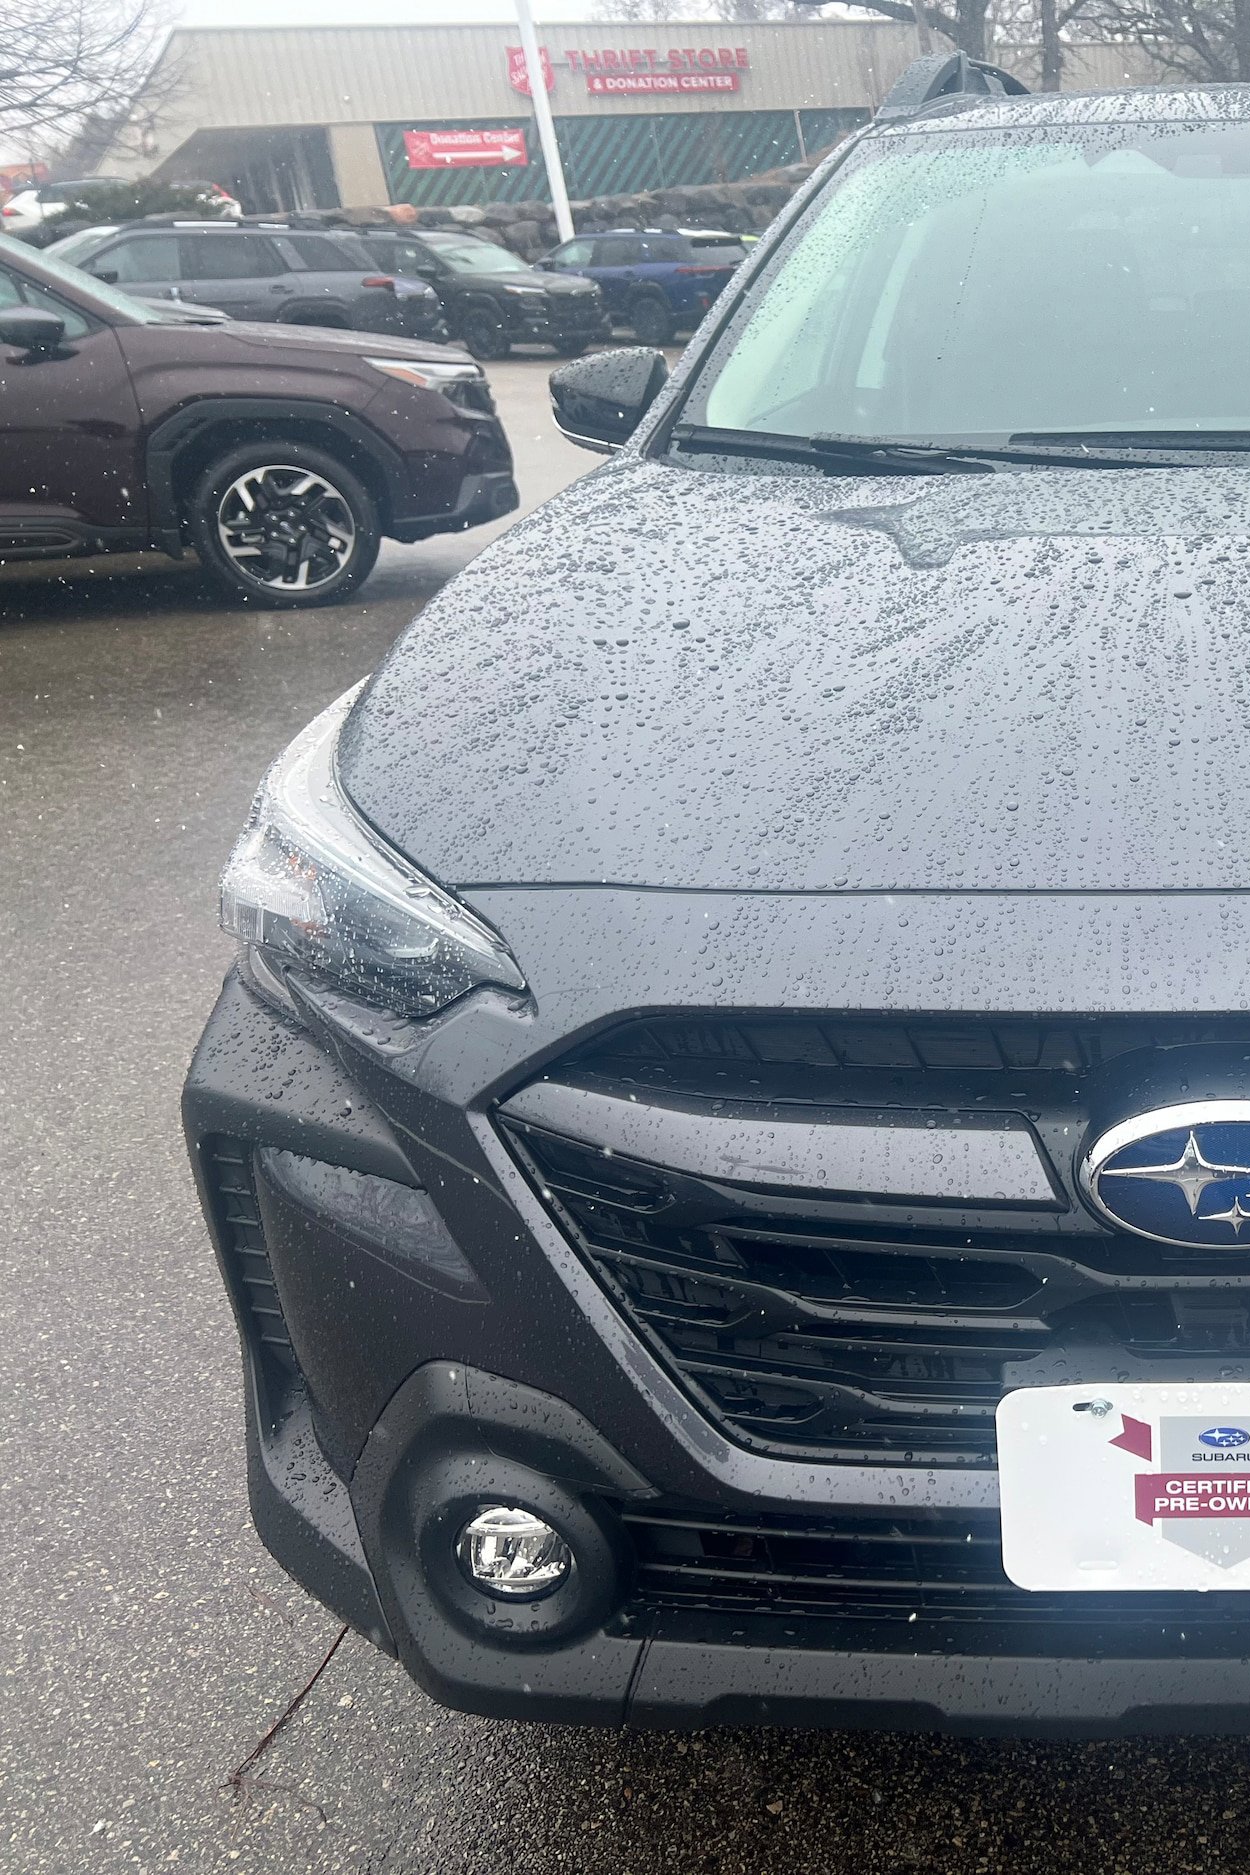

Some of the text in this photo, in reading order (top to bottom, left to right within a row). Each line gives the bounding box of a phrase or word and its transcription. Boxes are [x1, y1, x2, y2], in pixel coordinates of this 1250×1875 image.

[564, 47, 749, 71] THRIFT STORE
[592, 76, 733, 90] & DONATION CENTER
[430, 133, 482, 145] Donation
